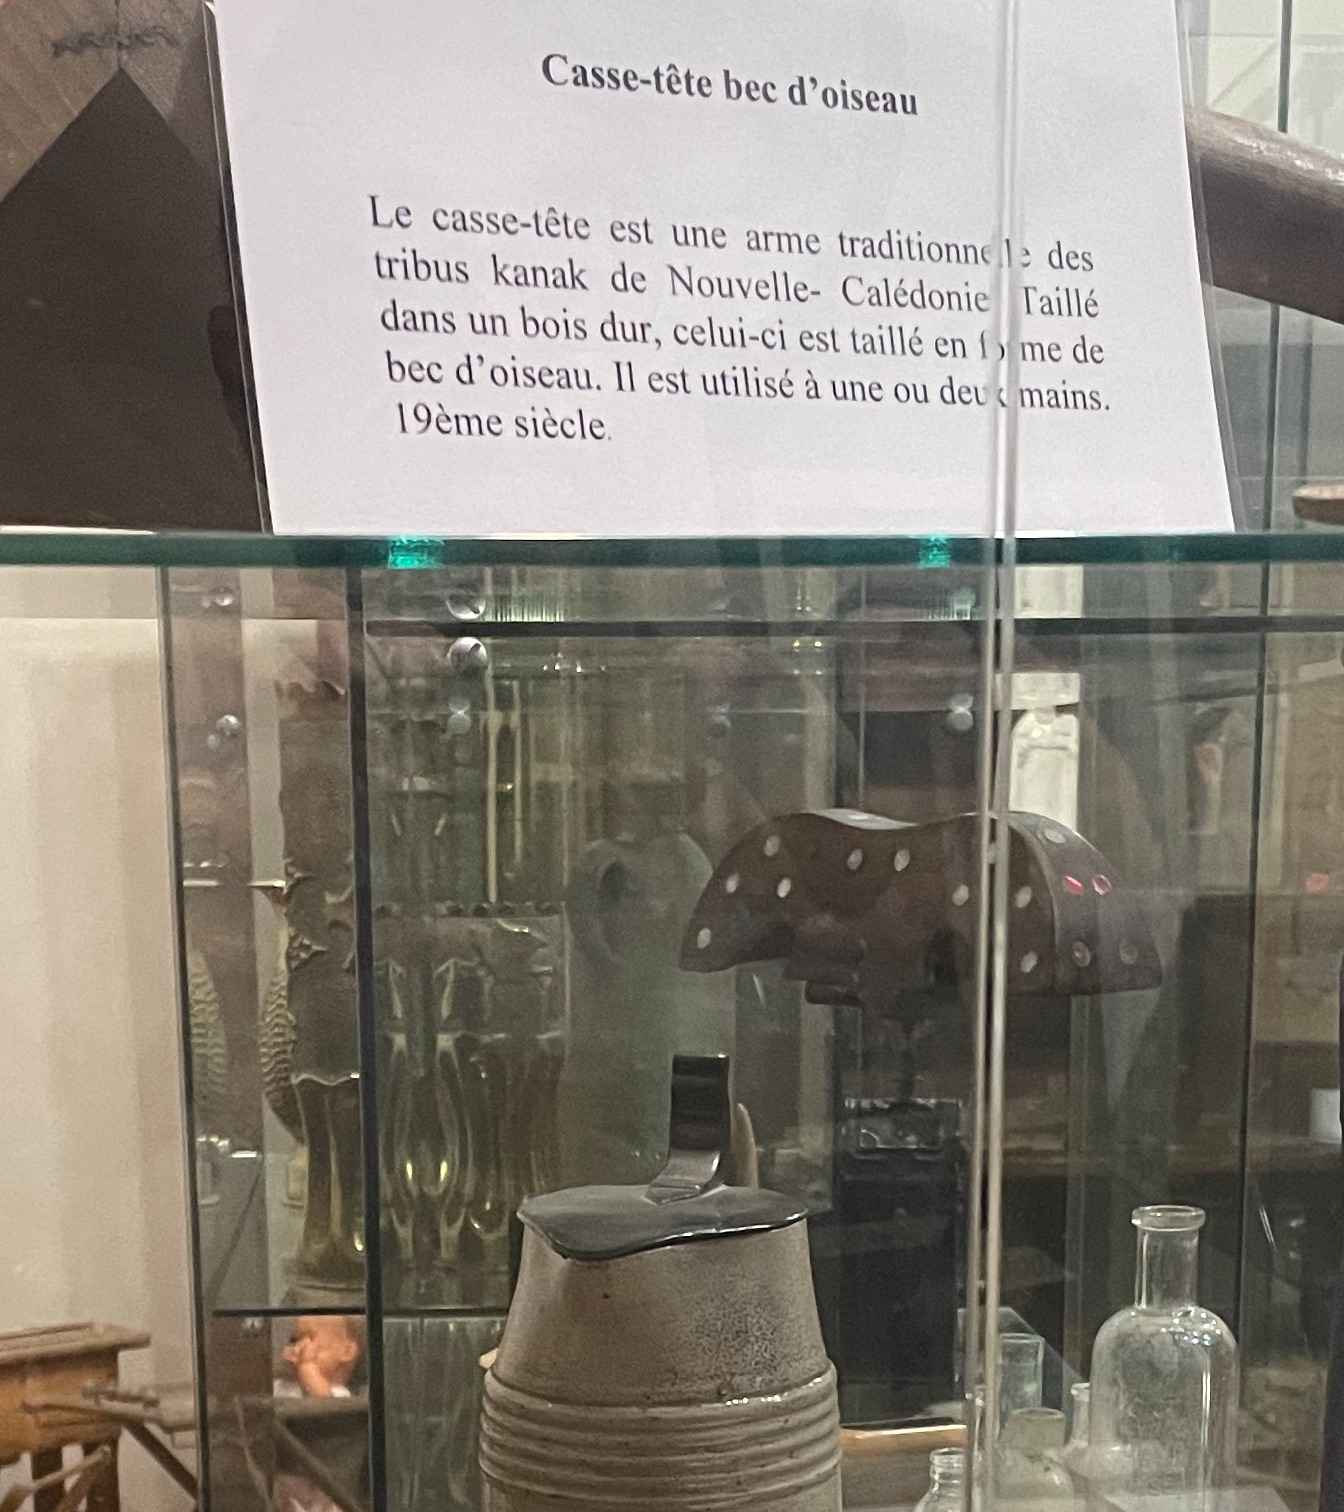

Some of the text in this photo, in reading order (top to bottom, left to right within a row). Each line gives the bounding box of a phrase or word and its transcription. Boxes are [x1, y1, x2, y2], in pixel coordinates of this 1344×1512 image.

[541, 53, 918, 116] Casse-tête bec d’oiseau
[369, 194, 412, 229] Le
[433, 207, 591, 241] casse-tête
[610, 217, 654, 245] est
[672, 224, 728, 249] une
[746, 229, 821, 255] arme
[1047, 240, 1094, 273] des
[375, 247, 470, 284] tribus
[492, 254, 590, 291] kanak
[611, 262, 648, 294] de
[667, 264, 821, 303] Nouvelle-
[1021, 285, 1100, 320] Taillé
[381, 298, 1106, 365] dans un bois dur, celui-ci est taillé en fme de
[386, 350, 444, 384] bec
[455, 353, 602, 392] d’oiseau.
[612, 360, 636, 393] Il
[648, 368, 691, 395] est
[701, 365, 795, 399] utilisé
[804, 370, 822, 400] à
[831, 379, 884, 403] une
[894, 384, 929, 406] ou
[1020, 380, 1110, 411] mains.
[397, 401, 612, 441] 19ème siècle.
